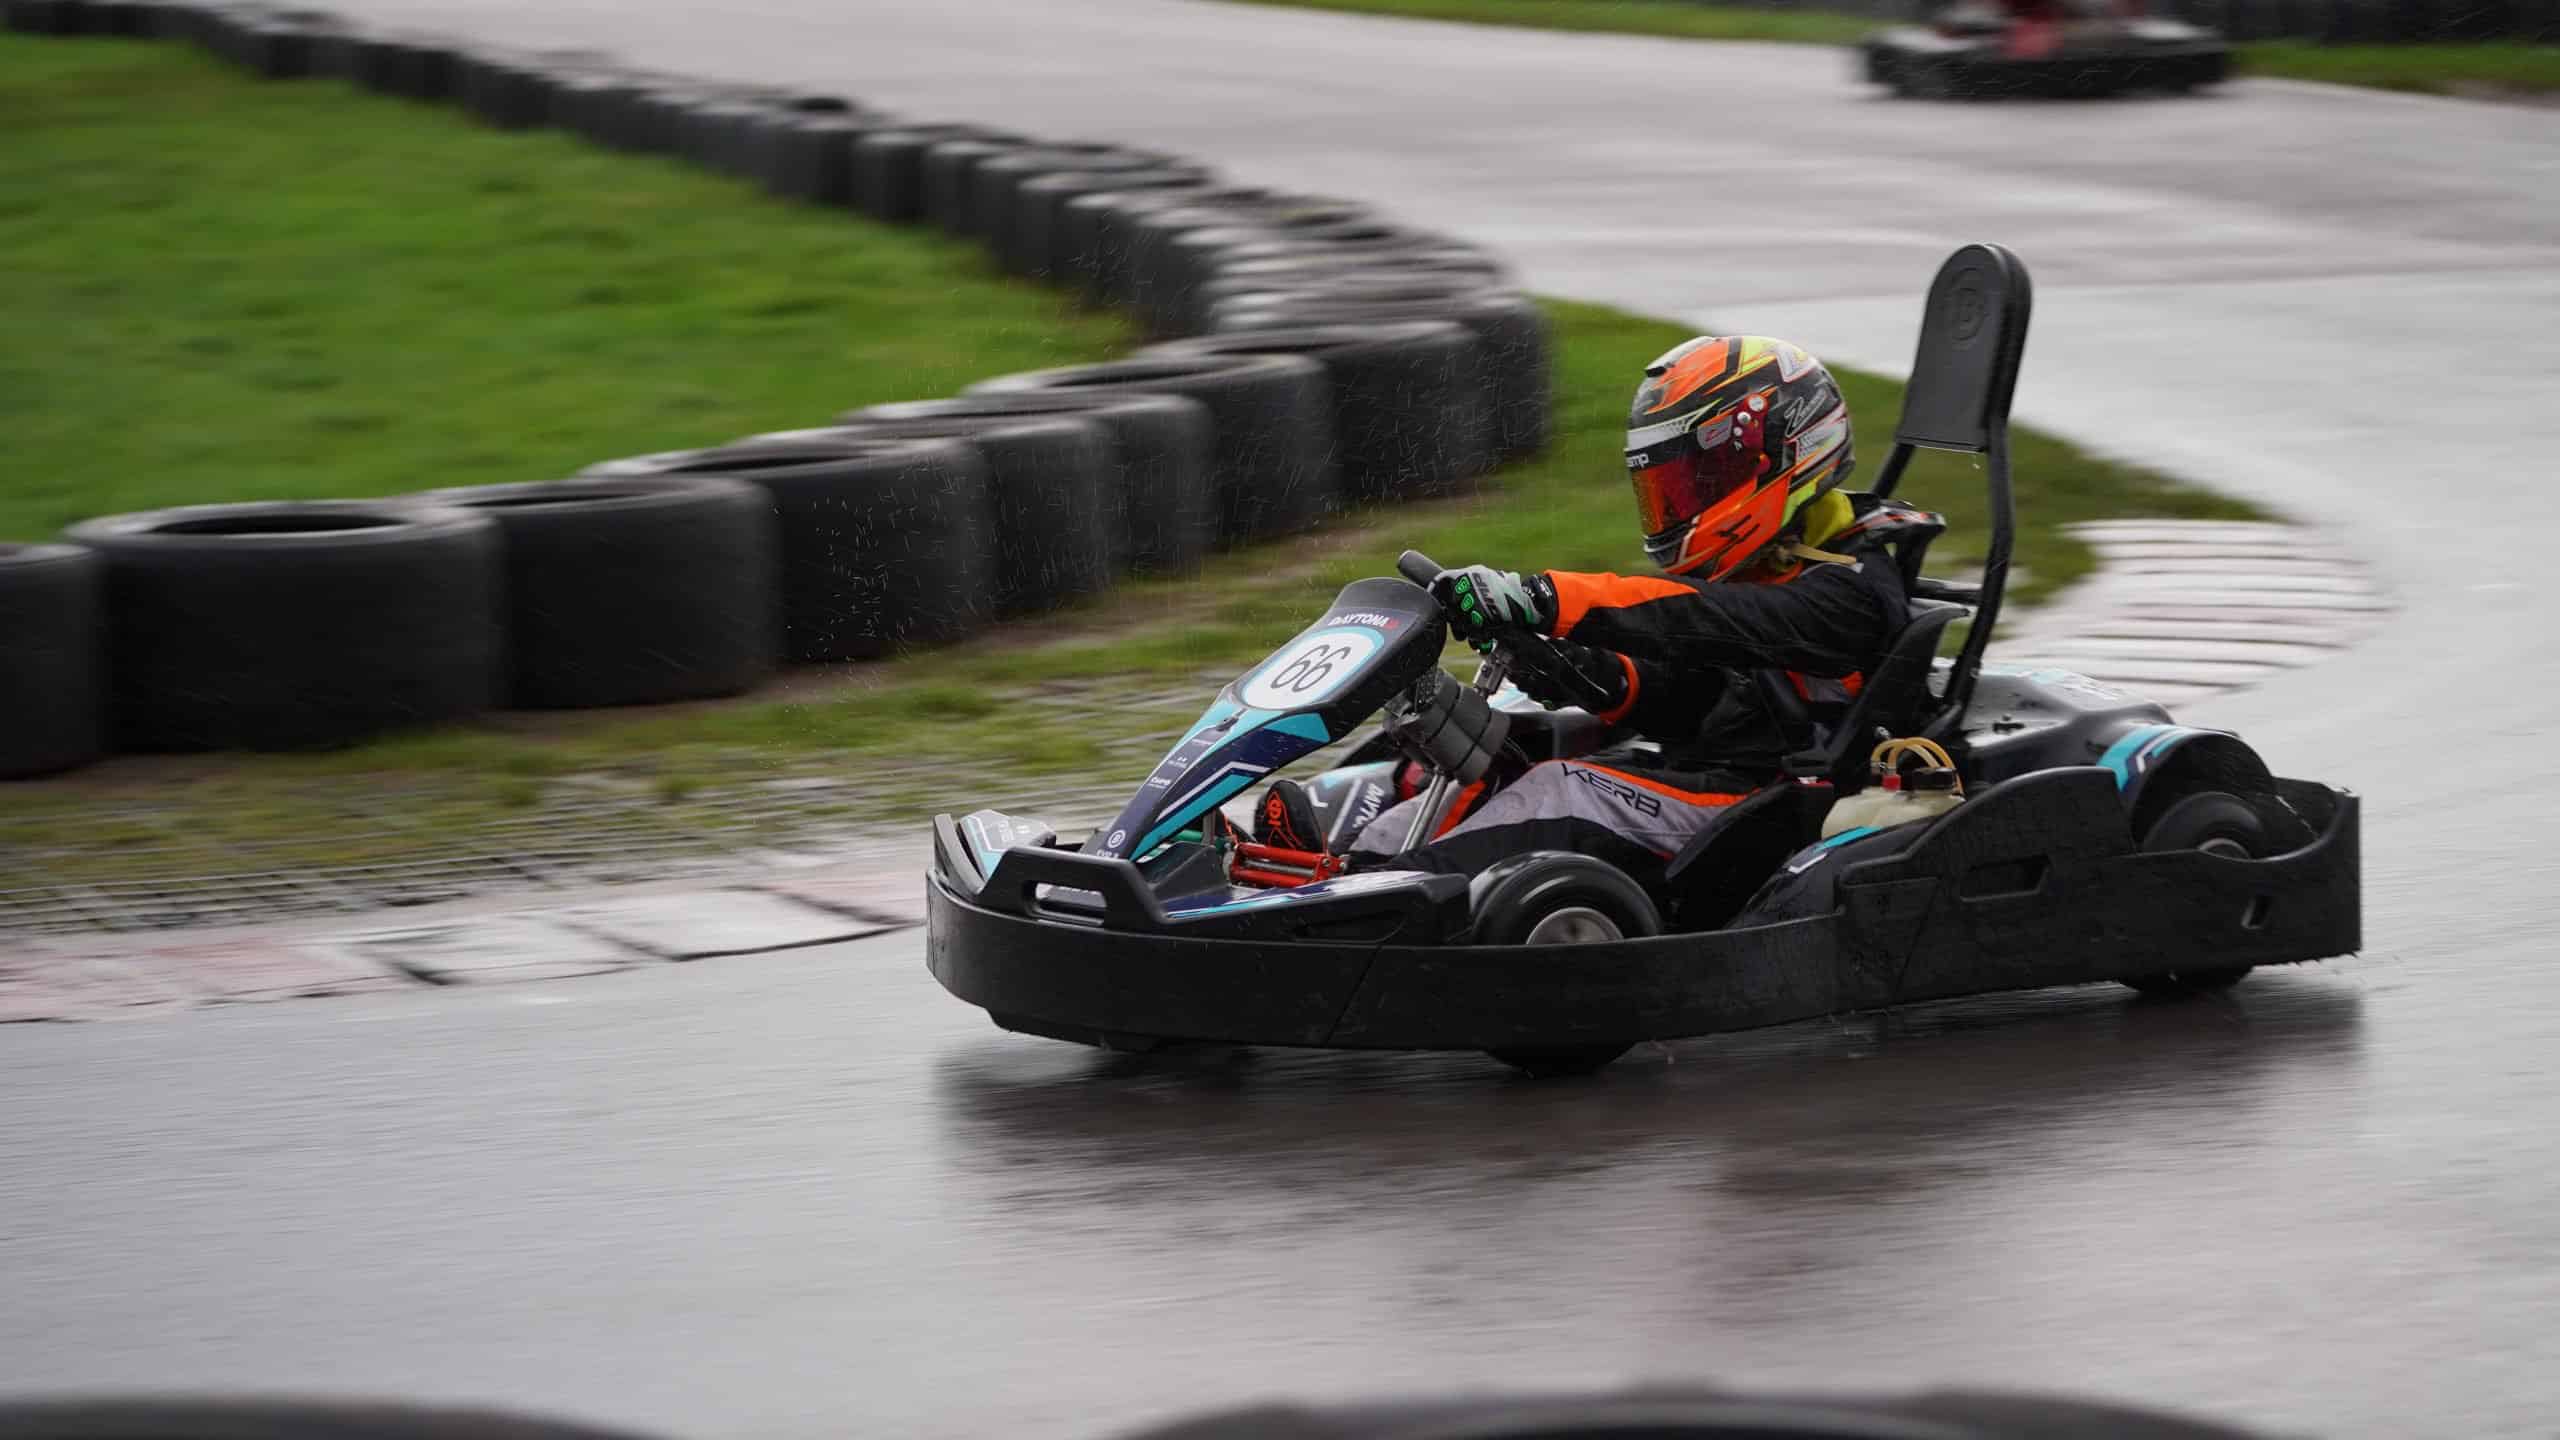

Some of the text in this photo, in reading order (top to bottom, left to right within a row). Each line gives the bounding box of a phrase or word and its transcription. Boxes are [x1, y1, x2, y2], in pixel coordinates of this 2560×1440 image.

[1328, 612, 1389, 627] DAYTONA
[1270, 644, 1352, 693] 66
[1561, 762, 1662, 818] KERB
